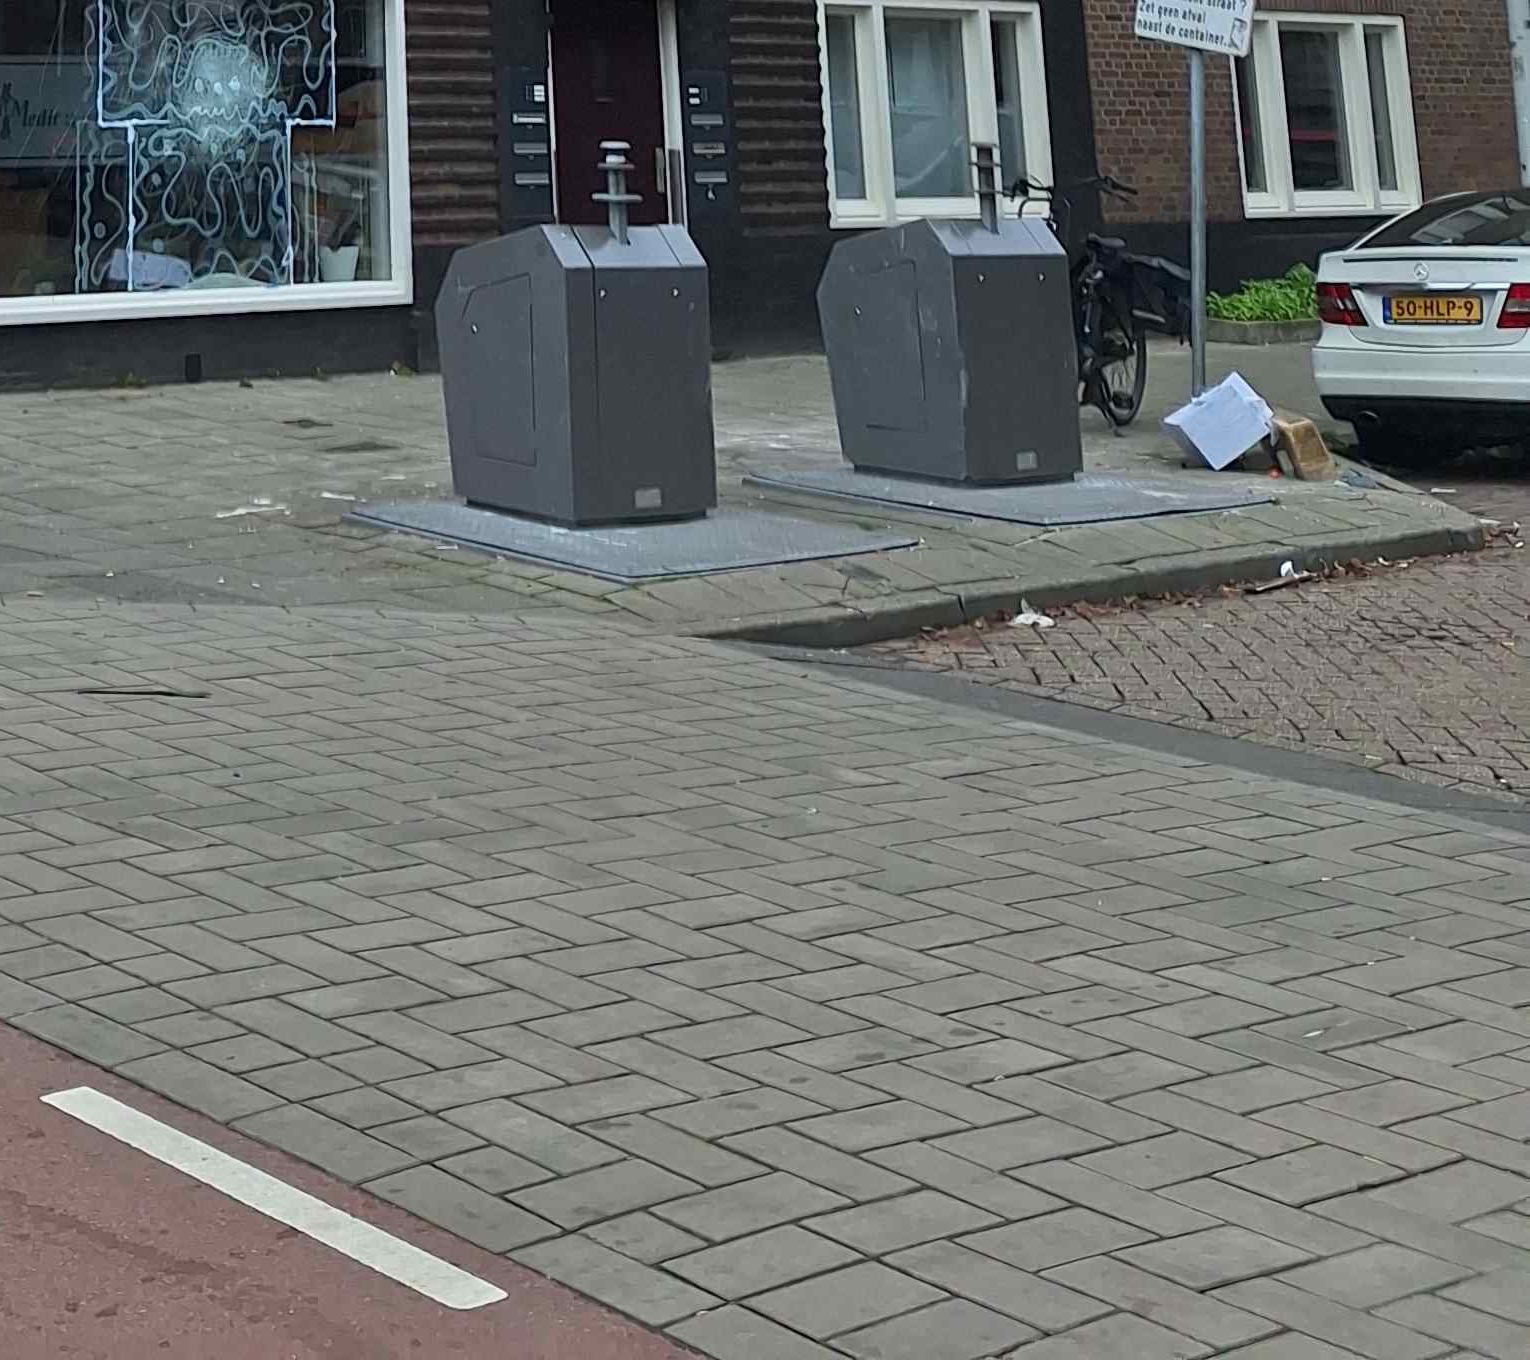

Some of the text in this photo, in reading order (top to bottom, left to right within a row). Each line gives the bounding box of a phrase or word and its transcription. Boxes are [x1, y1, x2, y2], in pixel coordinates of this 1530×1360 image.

[1157, 5, 1180, 19] geen
[1181, 8, 1207, 24] afval
[1136, 18, 1163, 32] naast
[1165, 22, 1176, 35] de
[1396, 300, 1474, 317] 50-HLP-9
